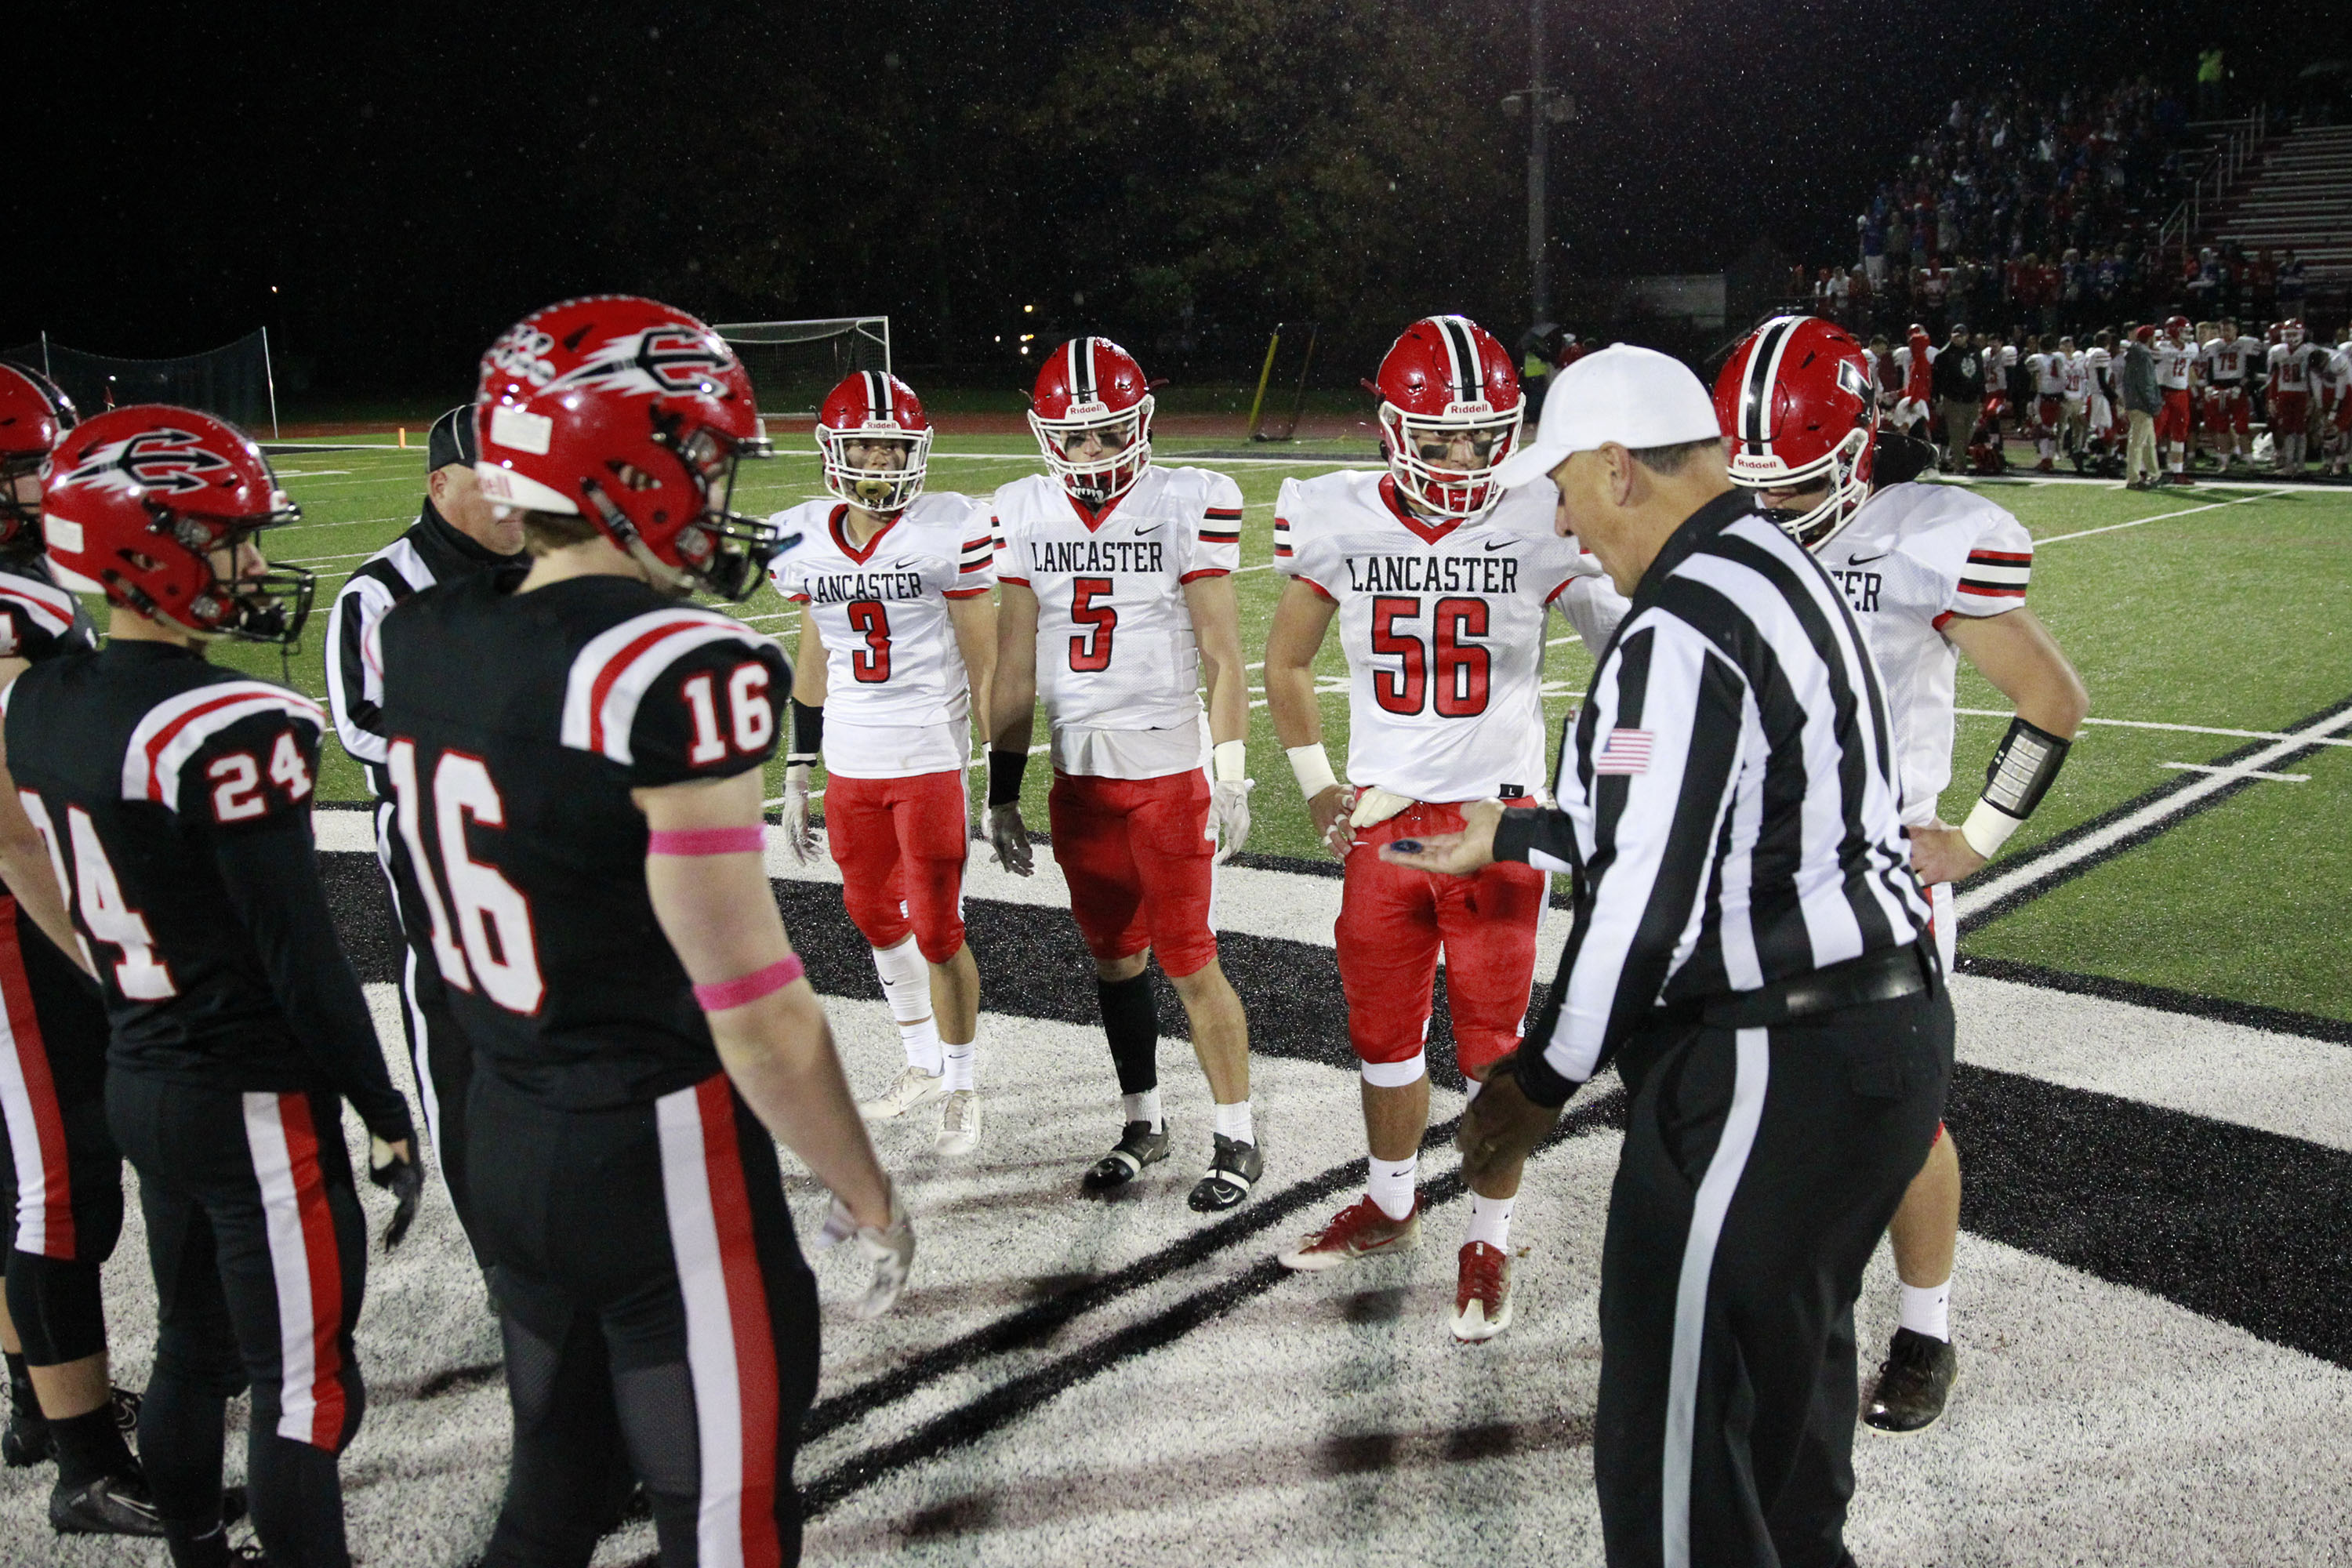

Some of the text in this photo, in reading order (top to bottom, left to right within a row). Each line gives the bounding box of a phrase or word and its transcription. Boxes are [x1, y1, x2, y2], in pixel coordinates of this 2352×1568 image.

[1069, 404, 1103, 415] Riddell
[1450, 403, 1488, 414] Riddell
[1737, 459, 1777, 469] Riddell
[1031, 541, 1163, 572] LANCASTER
[804, 572, 923, 603] LANCASTER
[1346, 557, 1518, 593] LANCASTER
[847, 599, 892, 684] 3
[1069, 576, 1118, 673] 5
[1370, 594, 1491, 719] 56
[682, 661, 775, 768] 16
[207, 728, 313, 824] 24
[1508, 786, 1515, 797] L
[388, 737, 546, 1017] 16
